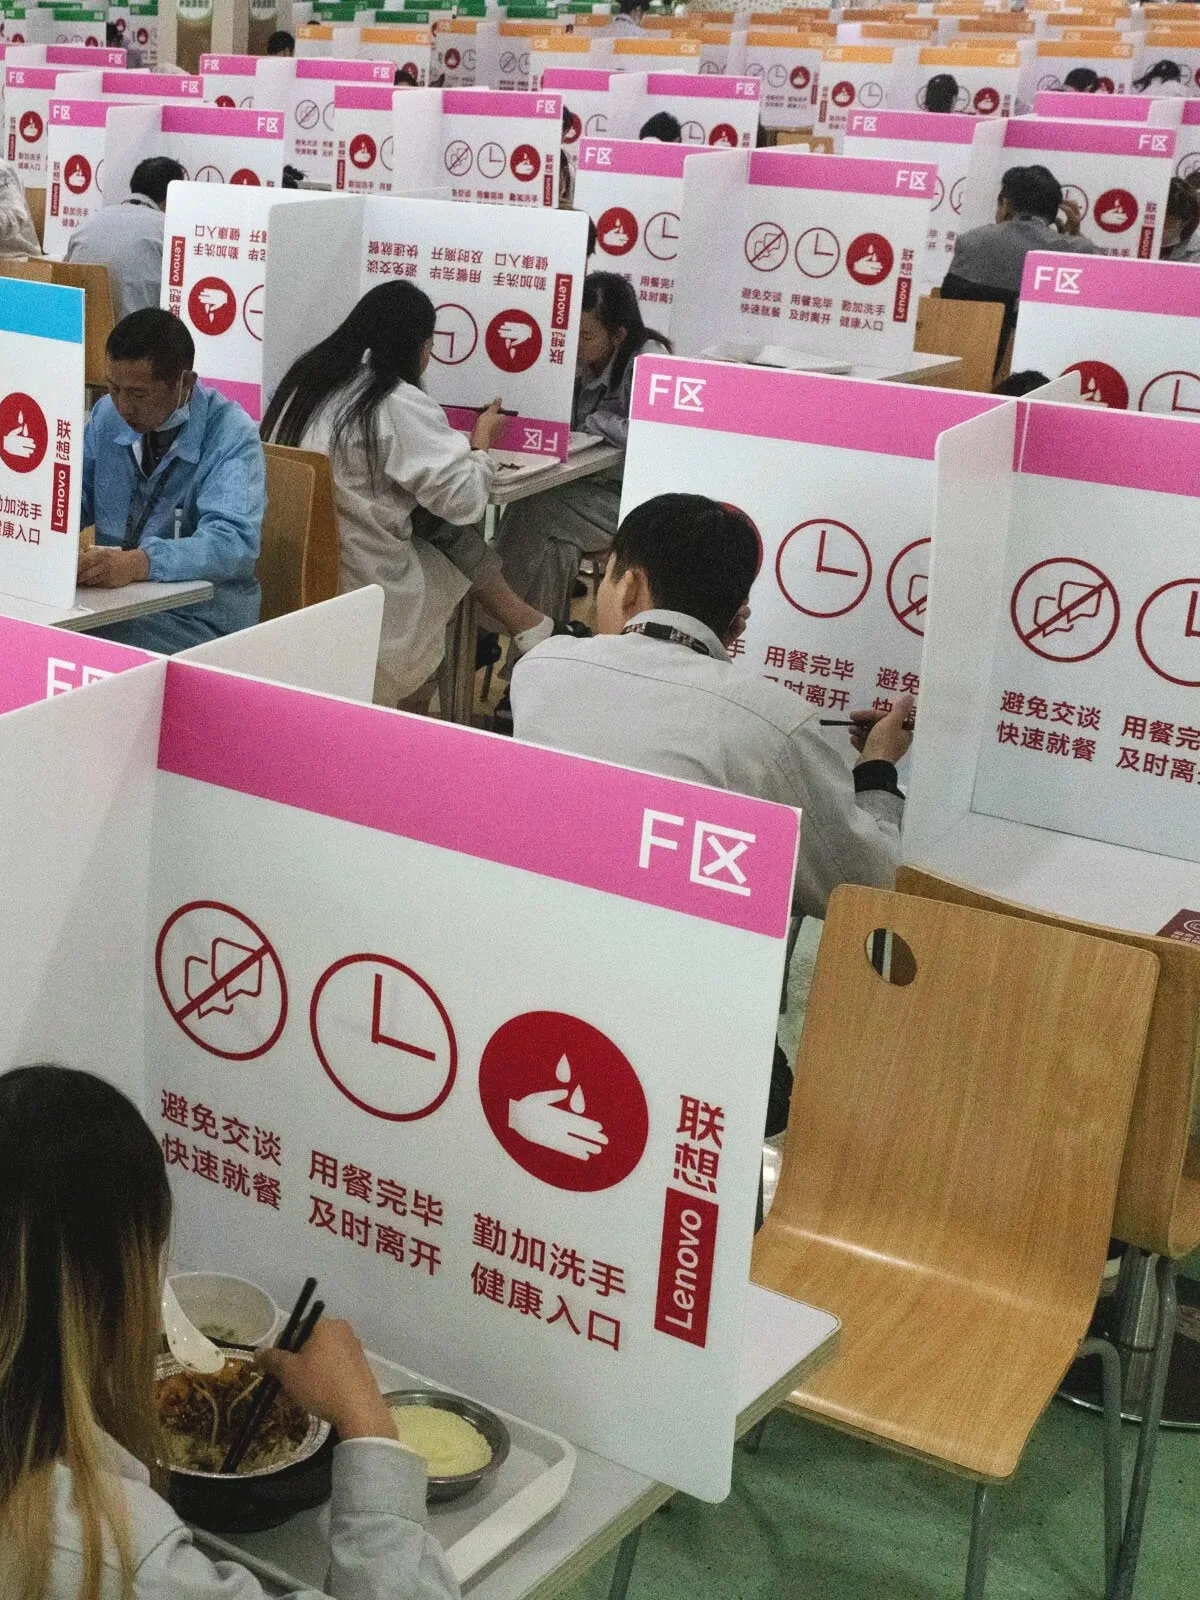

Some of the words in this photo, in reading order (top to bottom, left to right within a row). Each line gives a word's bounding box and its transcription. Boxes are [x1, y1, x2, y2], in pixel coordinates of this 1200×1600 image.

[108, 53, 122, 65] F区
[204, 59, 220, 71] F区
[9, 71, 25, 84] F区
[373, 66, 390, 79] F区
[181, 80, 199, 94] F区
[735, 83, 754, 95] F区
[53, 105, 71, 119] F区
[536, 100, 556, 114] F区
[257, 117, 279, 134] F区
[852, 116, 878, 132] F区
[1138, 135, 1168, 152] F区
[584, 148, 611, 165] F区
[896, 170, 929, 189] F区
[51, 184, 60, 215] Lenovo
[194, 224, 240, 241] 健康入口
[194, 242, 240, 260] 勤加洗手
[367, 239, 419, 258] 快速就餐
[431, 245, 483, 264] 及时离开
[172, 239, 183, 283] Lenovo
[366, 259, 418, 277] 避免交谈
[494, 251, 549, 271] 健康入口
[901, 248, 915, 276] 联想
[429, 266, 482, 283] 用餐完毕
[492, 272, 547, 291] 勤加洗手
[1033, 265, 1083, 295] F区
[555, 276, 568, 327] Lenovo
[741, 287, 782, 303] 避免交谈
[790, 293, 833, 309] 用餐完毕
[841, 300, 886, 316] 勤加洗手
[897, 280, 910, 320] Lenovo
[789, 309, 832, 325] 及时离开
[839, 316, 884, 331] 健康入口
[549, 330, 566, 365] 联想
[648, 373, 707, 412] F区
[55, 418, 72, 463] 联想
[522, 427, 558, 451] F区
[53, 469, 67, 529] Lenovo
[763, 645, 855, 681] 用餐完毕
[762, 674, 850, 712] 离开
[999, 690, 1103, 731] 避免交谈
[996, 720, 1098, 763] 快速就餐
[1116, 746, 1200, 785] 及时离
[638, 807, 758, 897] F区
[672, 1092, 726, 1194] 联想
[159, 1087, 284, 1167] 避免交谈
[308, 1148, 445, 1229] 用餐完毕
[471, 1211, 627, 1299] 勤加洗手
[162, 1132, 284, 1212] 快速就餐
[307, 1193, 443, 1277] 及时离开
[469, 1261, 623, 1353] 健康入口
[664, 1207, 703, 1331] Lenovo
